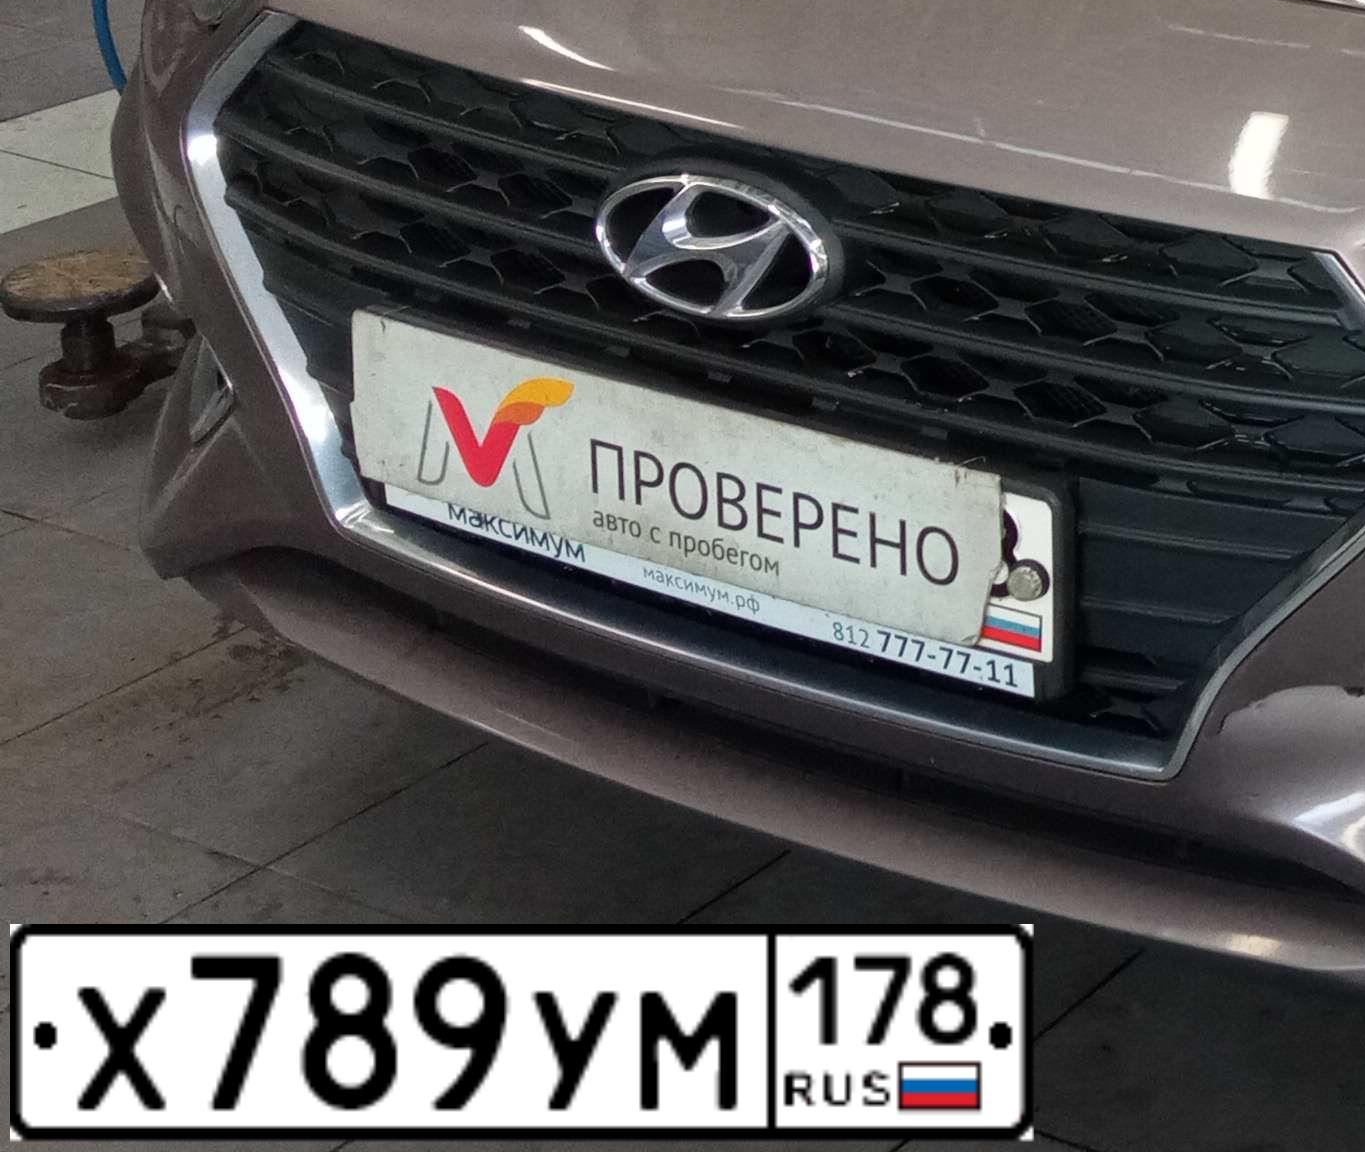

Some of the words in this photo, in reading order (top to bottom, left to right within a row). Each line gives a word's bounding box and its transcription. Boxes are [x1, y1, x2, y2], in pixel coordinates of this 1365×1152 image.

[448, 502, 586, 563] максимум
[590, 438, 959, 586] ПРОВЕРЕНО
[593, 510, 642, 539] авто
[650, 526, 661, 544] с
[669, 530, 781, 577] пробегом
[643, 566, 761, 615] максимум.рф
[832, 622, 871, 649] 812
[876, 629, 1018, 688] 777-77-11
